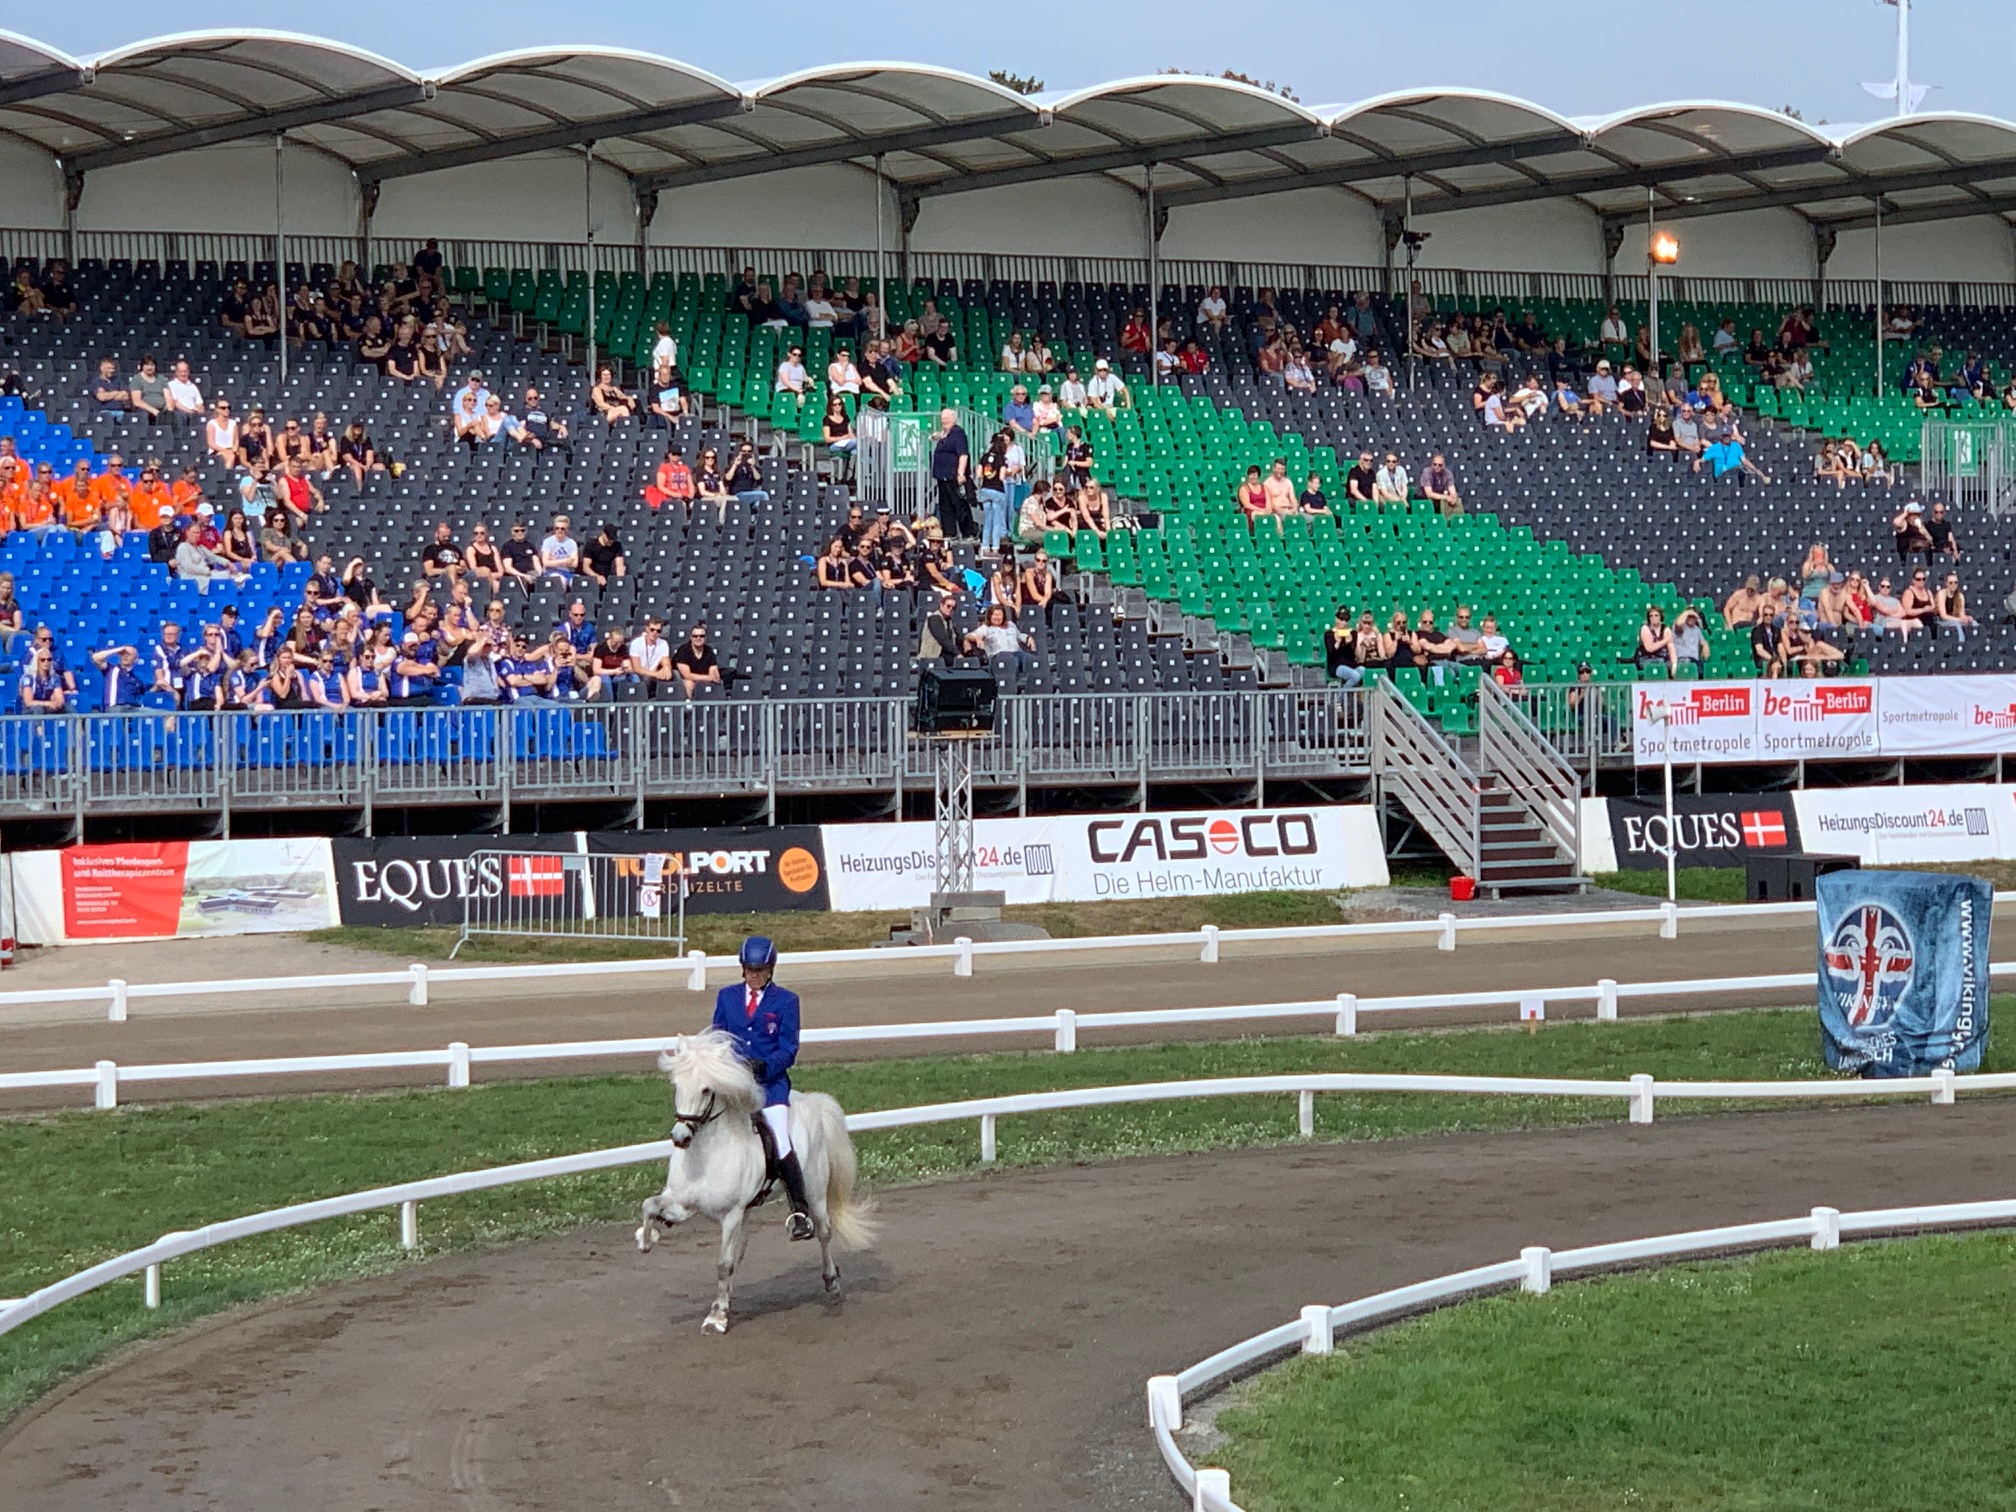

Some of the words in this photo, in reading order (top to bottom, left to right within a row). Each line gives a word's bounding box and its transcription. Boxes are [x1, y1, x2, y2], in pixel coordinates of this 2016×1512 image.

[1702, 693, 1745, 712] Berlin
[1763, 688, 1791, 716] be
[1826, 692, 1867, 710] Berlin
[1974, 704, 1993, 725] be
[1883, 709, 1959, 725] Sportmetropole
[1640, 733, 1750, 757] Spotmetropole
[1764, 731, 1873, 753] Sportmetropole
[1818, 809, 1964, 834] HeizungsDiscount24.de
[1623, 812, 1741, 859] EQUES
[840, 846, 1022, 875] HeizungsDist24.de
[352, 858, 503, 911] EQUES
[1093, 872, 1131, 895] Die
[1136, 866, 1323, 893] Helm-Manufaktur
